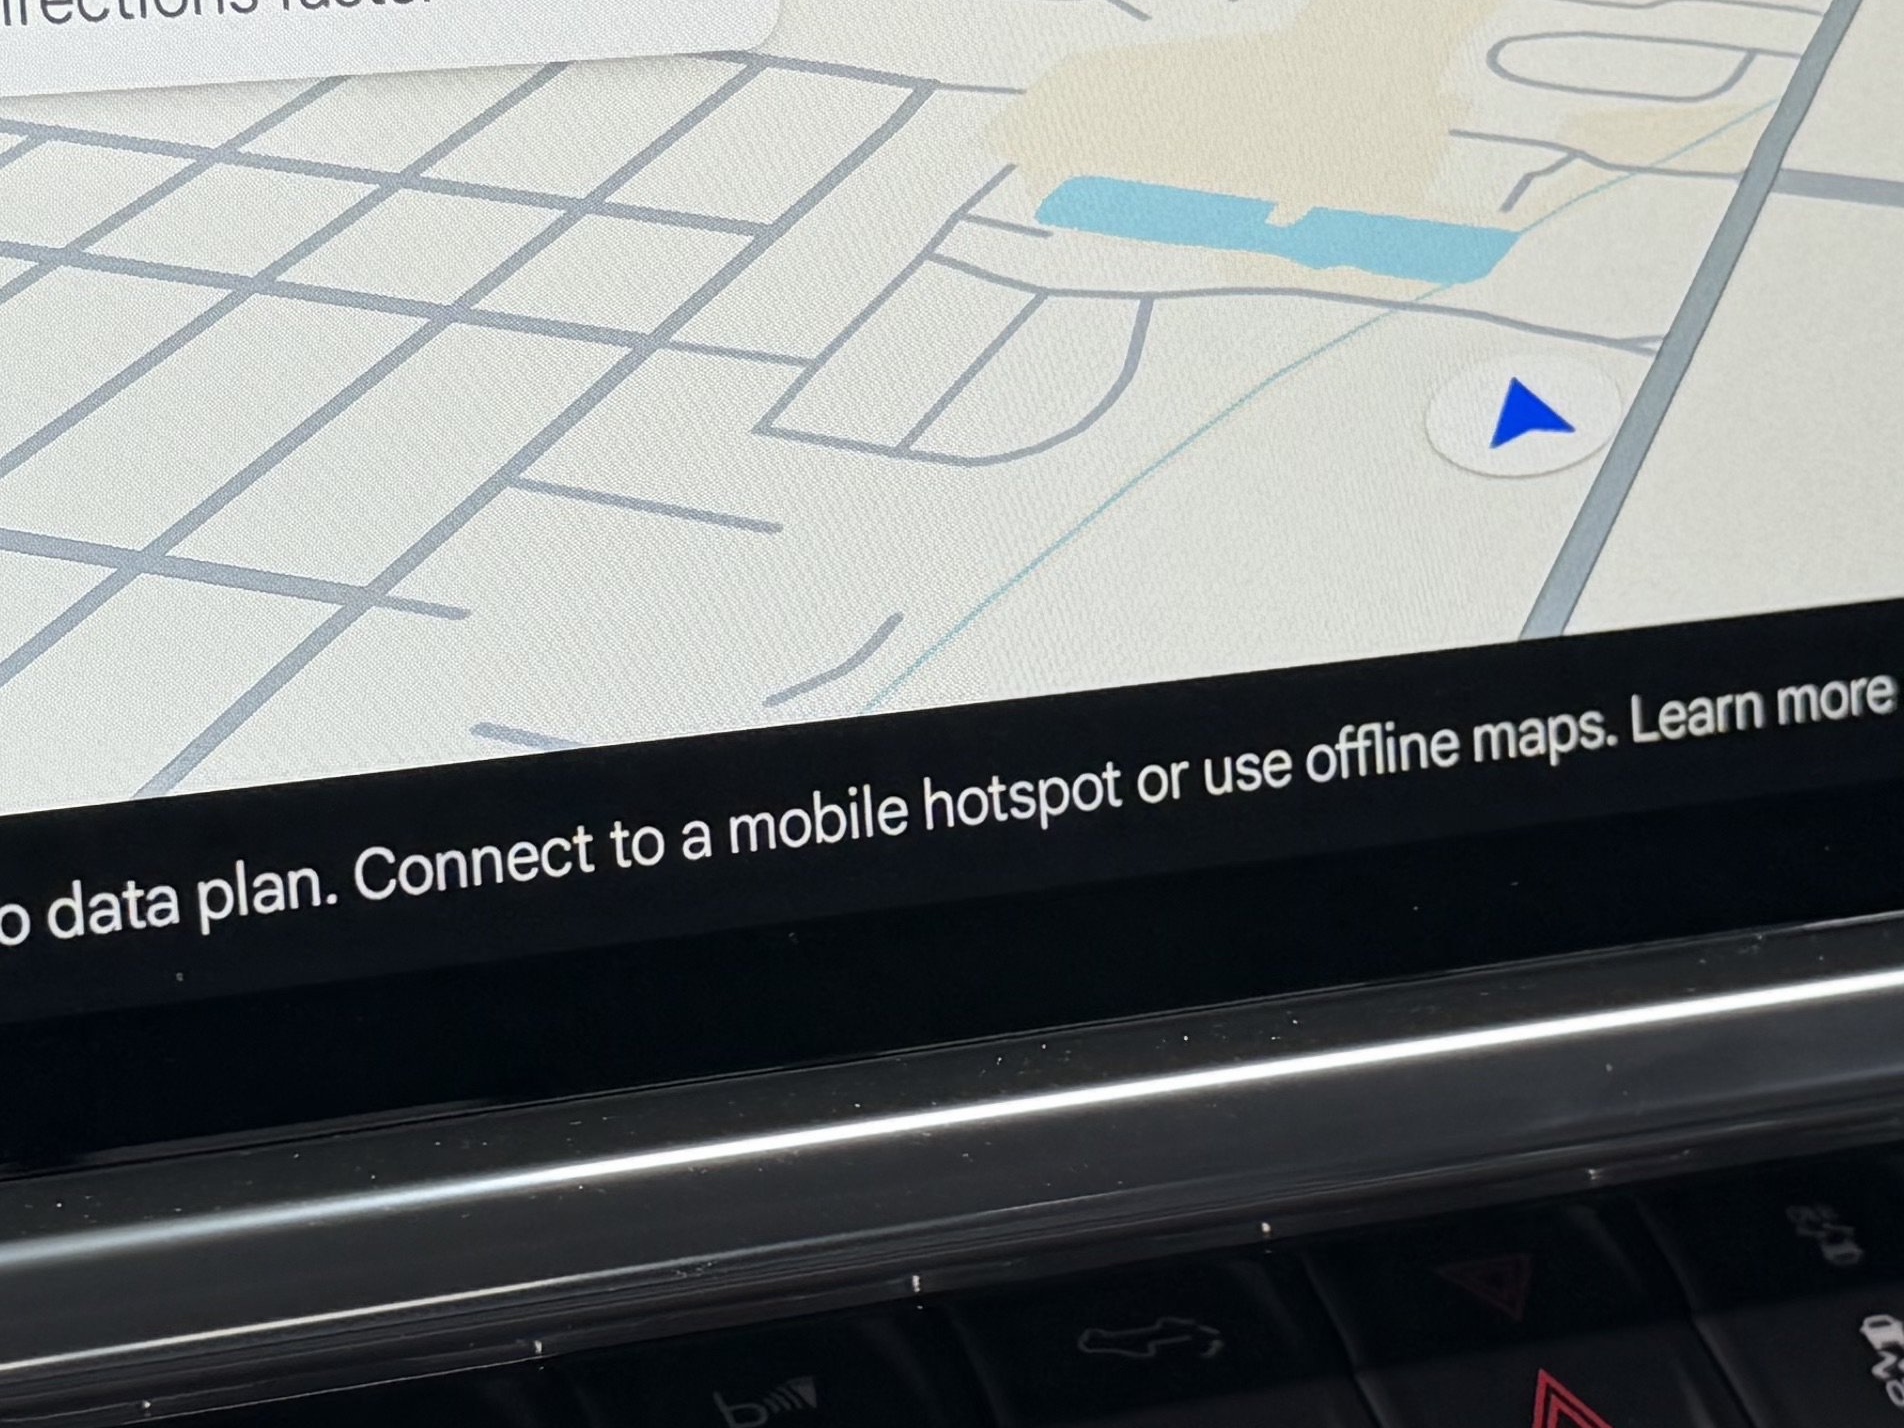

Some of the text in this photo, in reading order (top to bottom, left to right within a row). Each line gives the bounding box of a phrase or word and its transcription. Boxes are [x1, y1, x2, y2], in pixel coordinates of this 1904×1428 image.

[46, 878, 181, 940] data
[196, 858, 339, 937] plan.
[353, 824, 597, 901] Connect
[608, 819, 666, 869] to
[680, 819, 713, 862] a
[728, 782, 910, 855] mobile
[922, 760, 1124, 832] hotspot
[1136, 759, 1191, 805] or
[1203, 748, 1294, 797] use
[1305, 720, 1461, 784] offline
[1472, 710, 1619, 768] maps.
[1630, 690, 1765, 744] Learn
[1776, 674, 1896, 726] more
